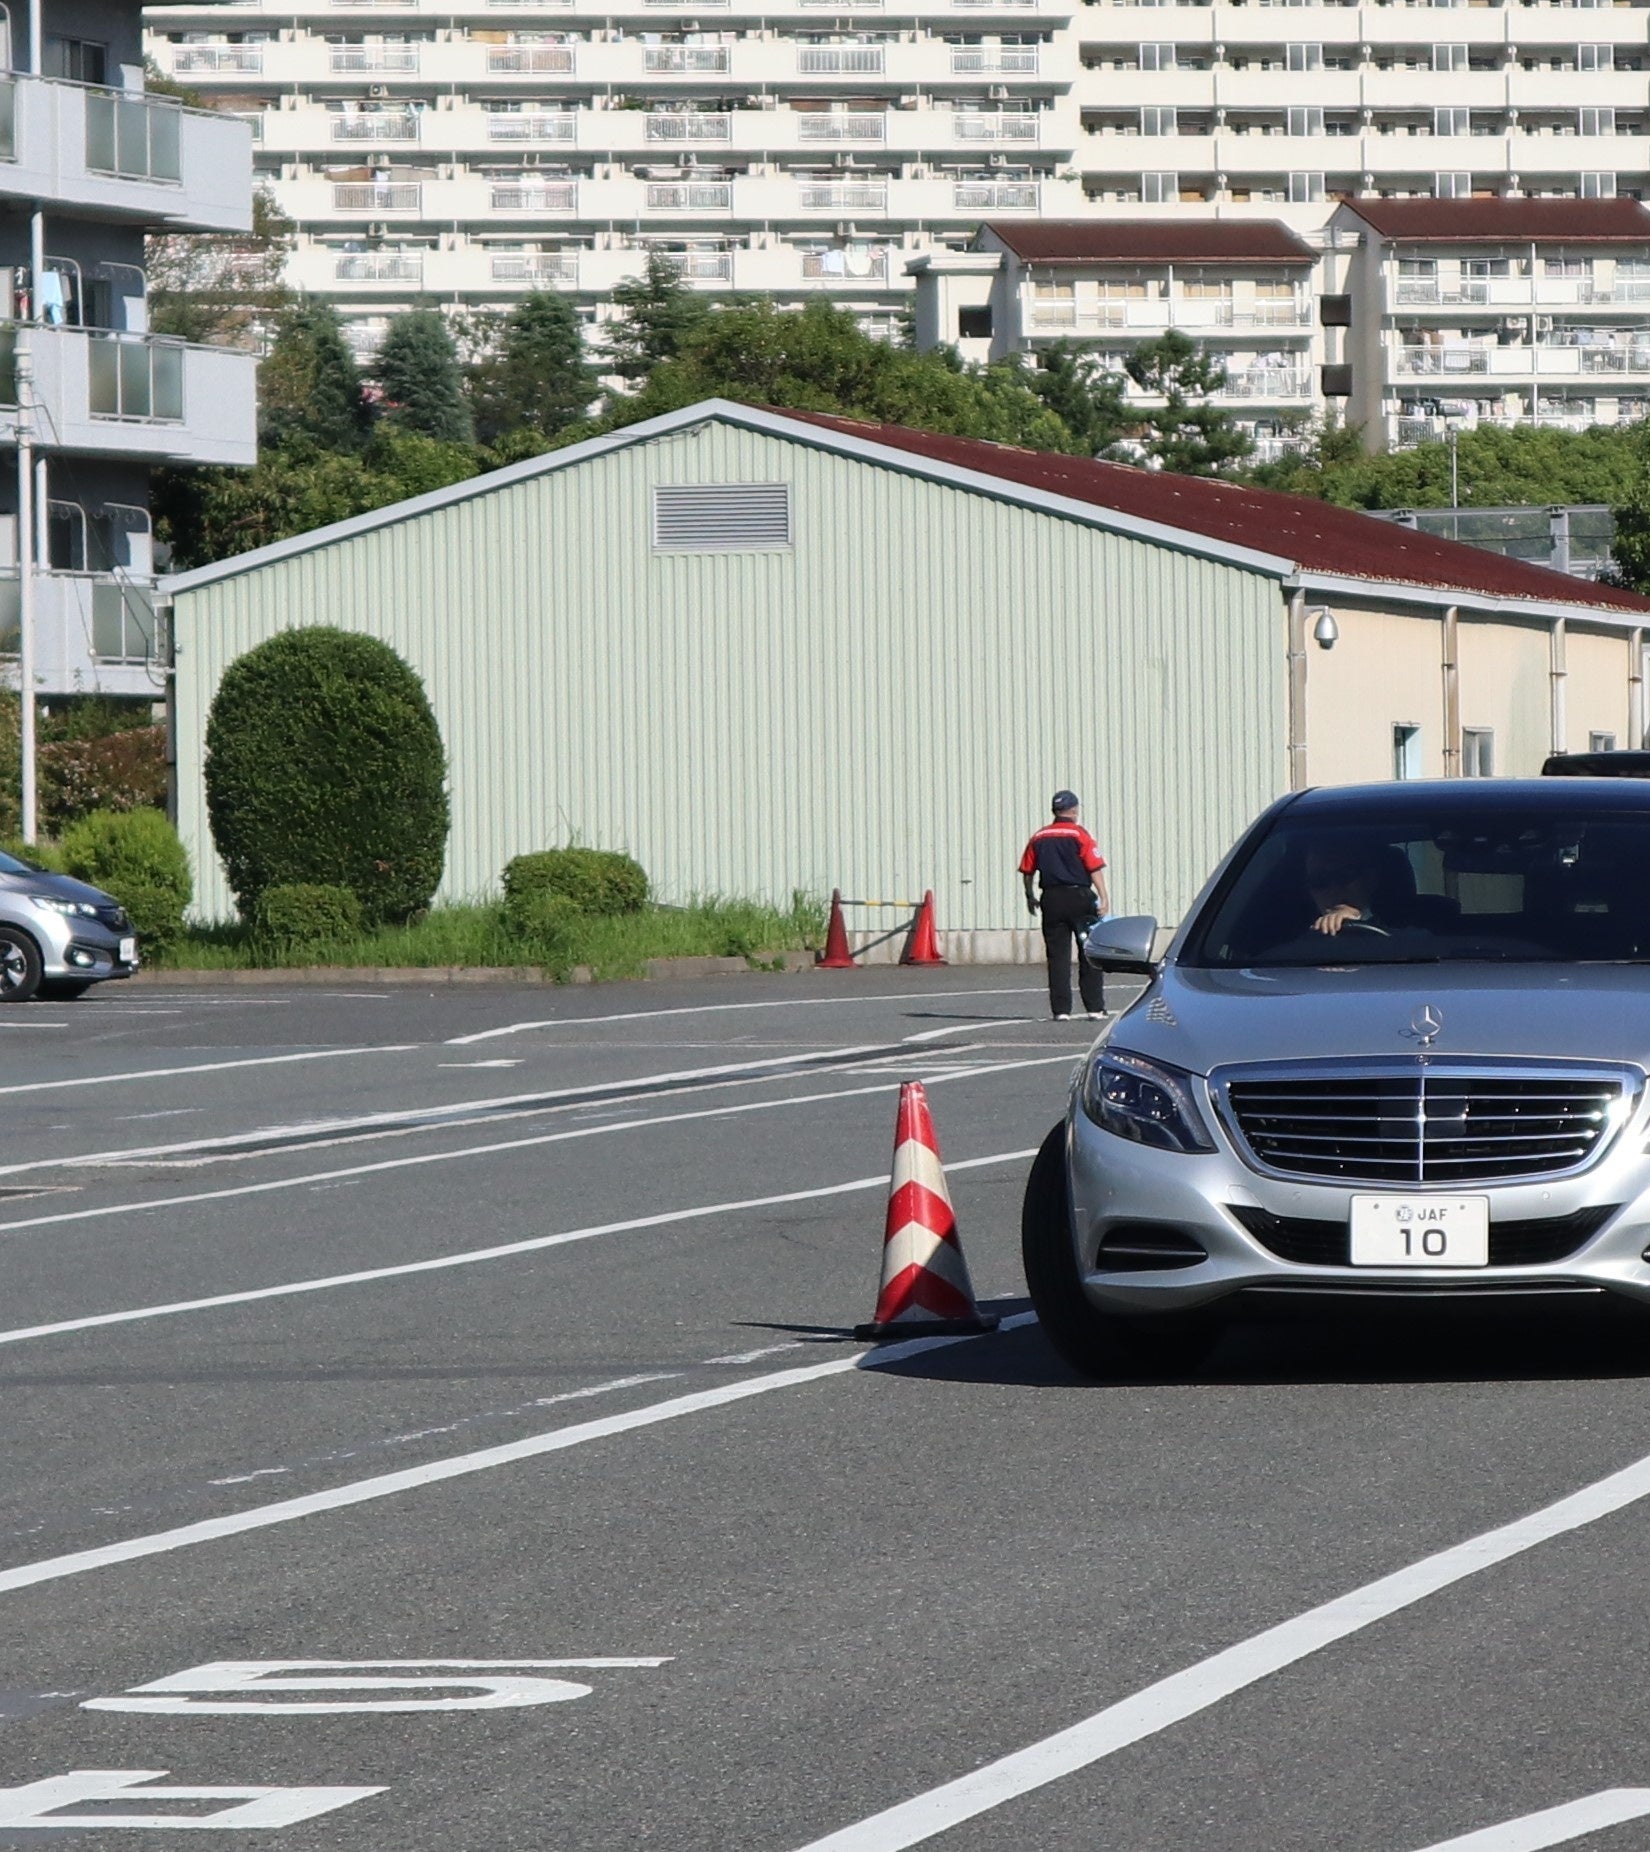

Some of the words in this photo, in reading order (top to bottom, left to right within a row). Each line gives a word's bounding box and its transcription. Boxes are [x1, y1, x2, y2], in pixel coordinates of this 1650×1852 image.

[1417, 1208, 1448, 1221] JAF
[1400, 1228, 1447, 1256] 10
[79, 1656, 676, 1714] 5
